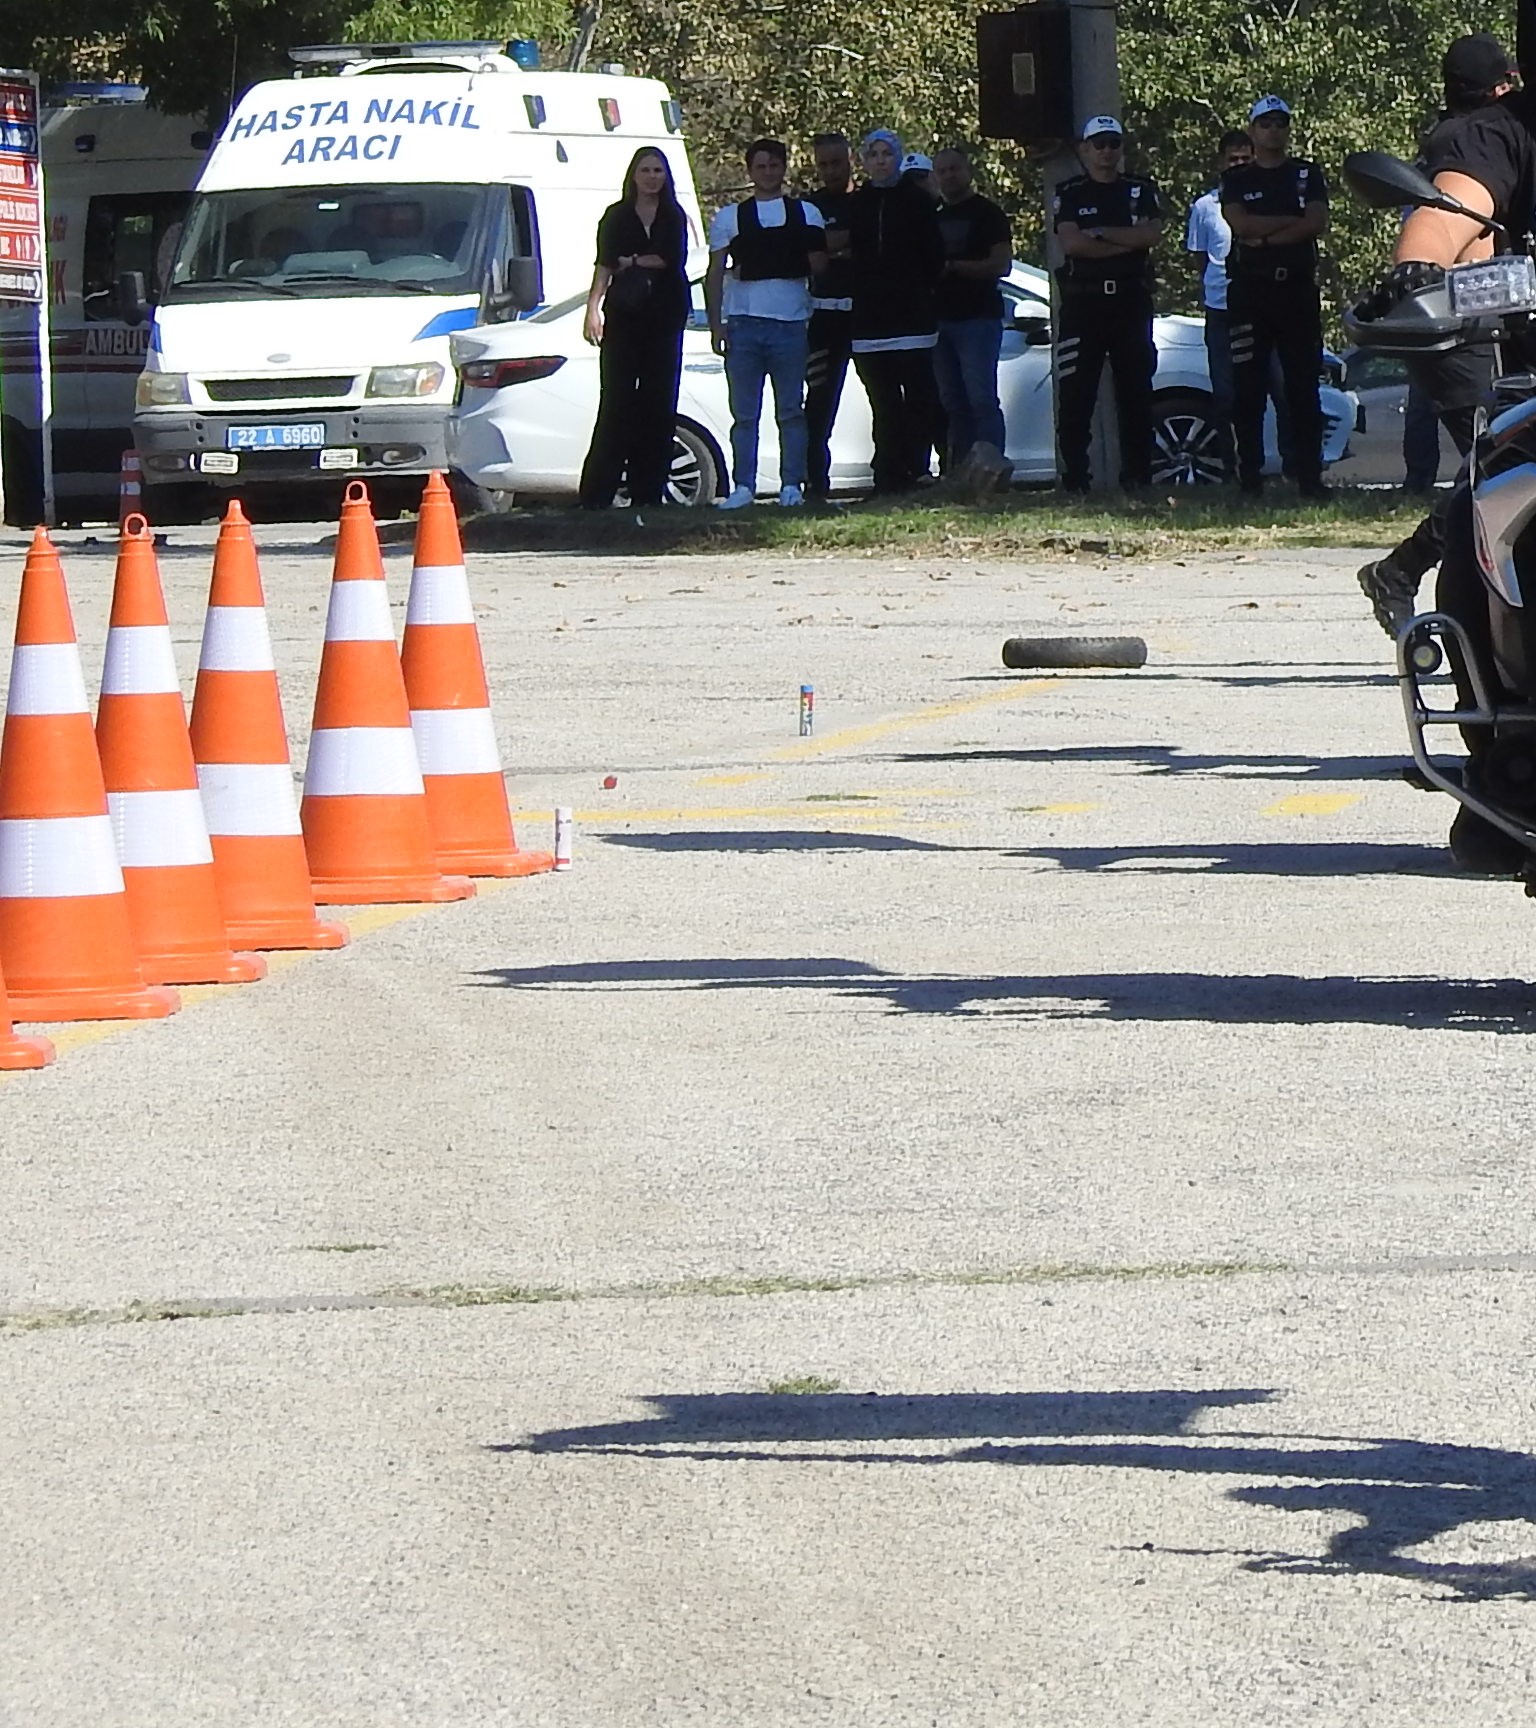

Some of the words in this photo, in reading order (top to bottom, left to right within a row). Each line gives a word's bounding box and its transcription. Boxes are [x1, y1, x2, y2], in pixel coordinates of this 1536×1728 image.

[230, 100, 349, 142] HASTA
[363, 96, 480, 130] NAKİL
[281, 134, 402, 166] ARACI
[237, 430, 257, 446] 22
[265, 429, 275, 444] A
[282, 427, 321, 445] 6960
